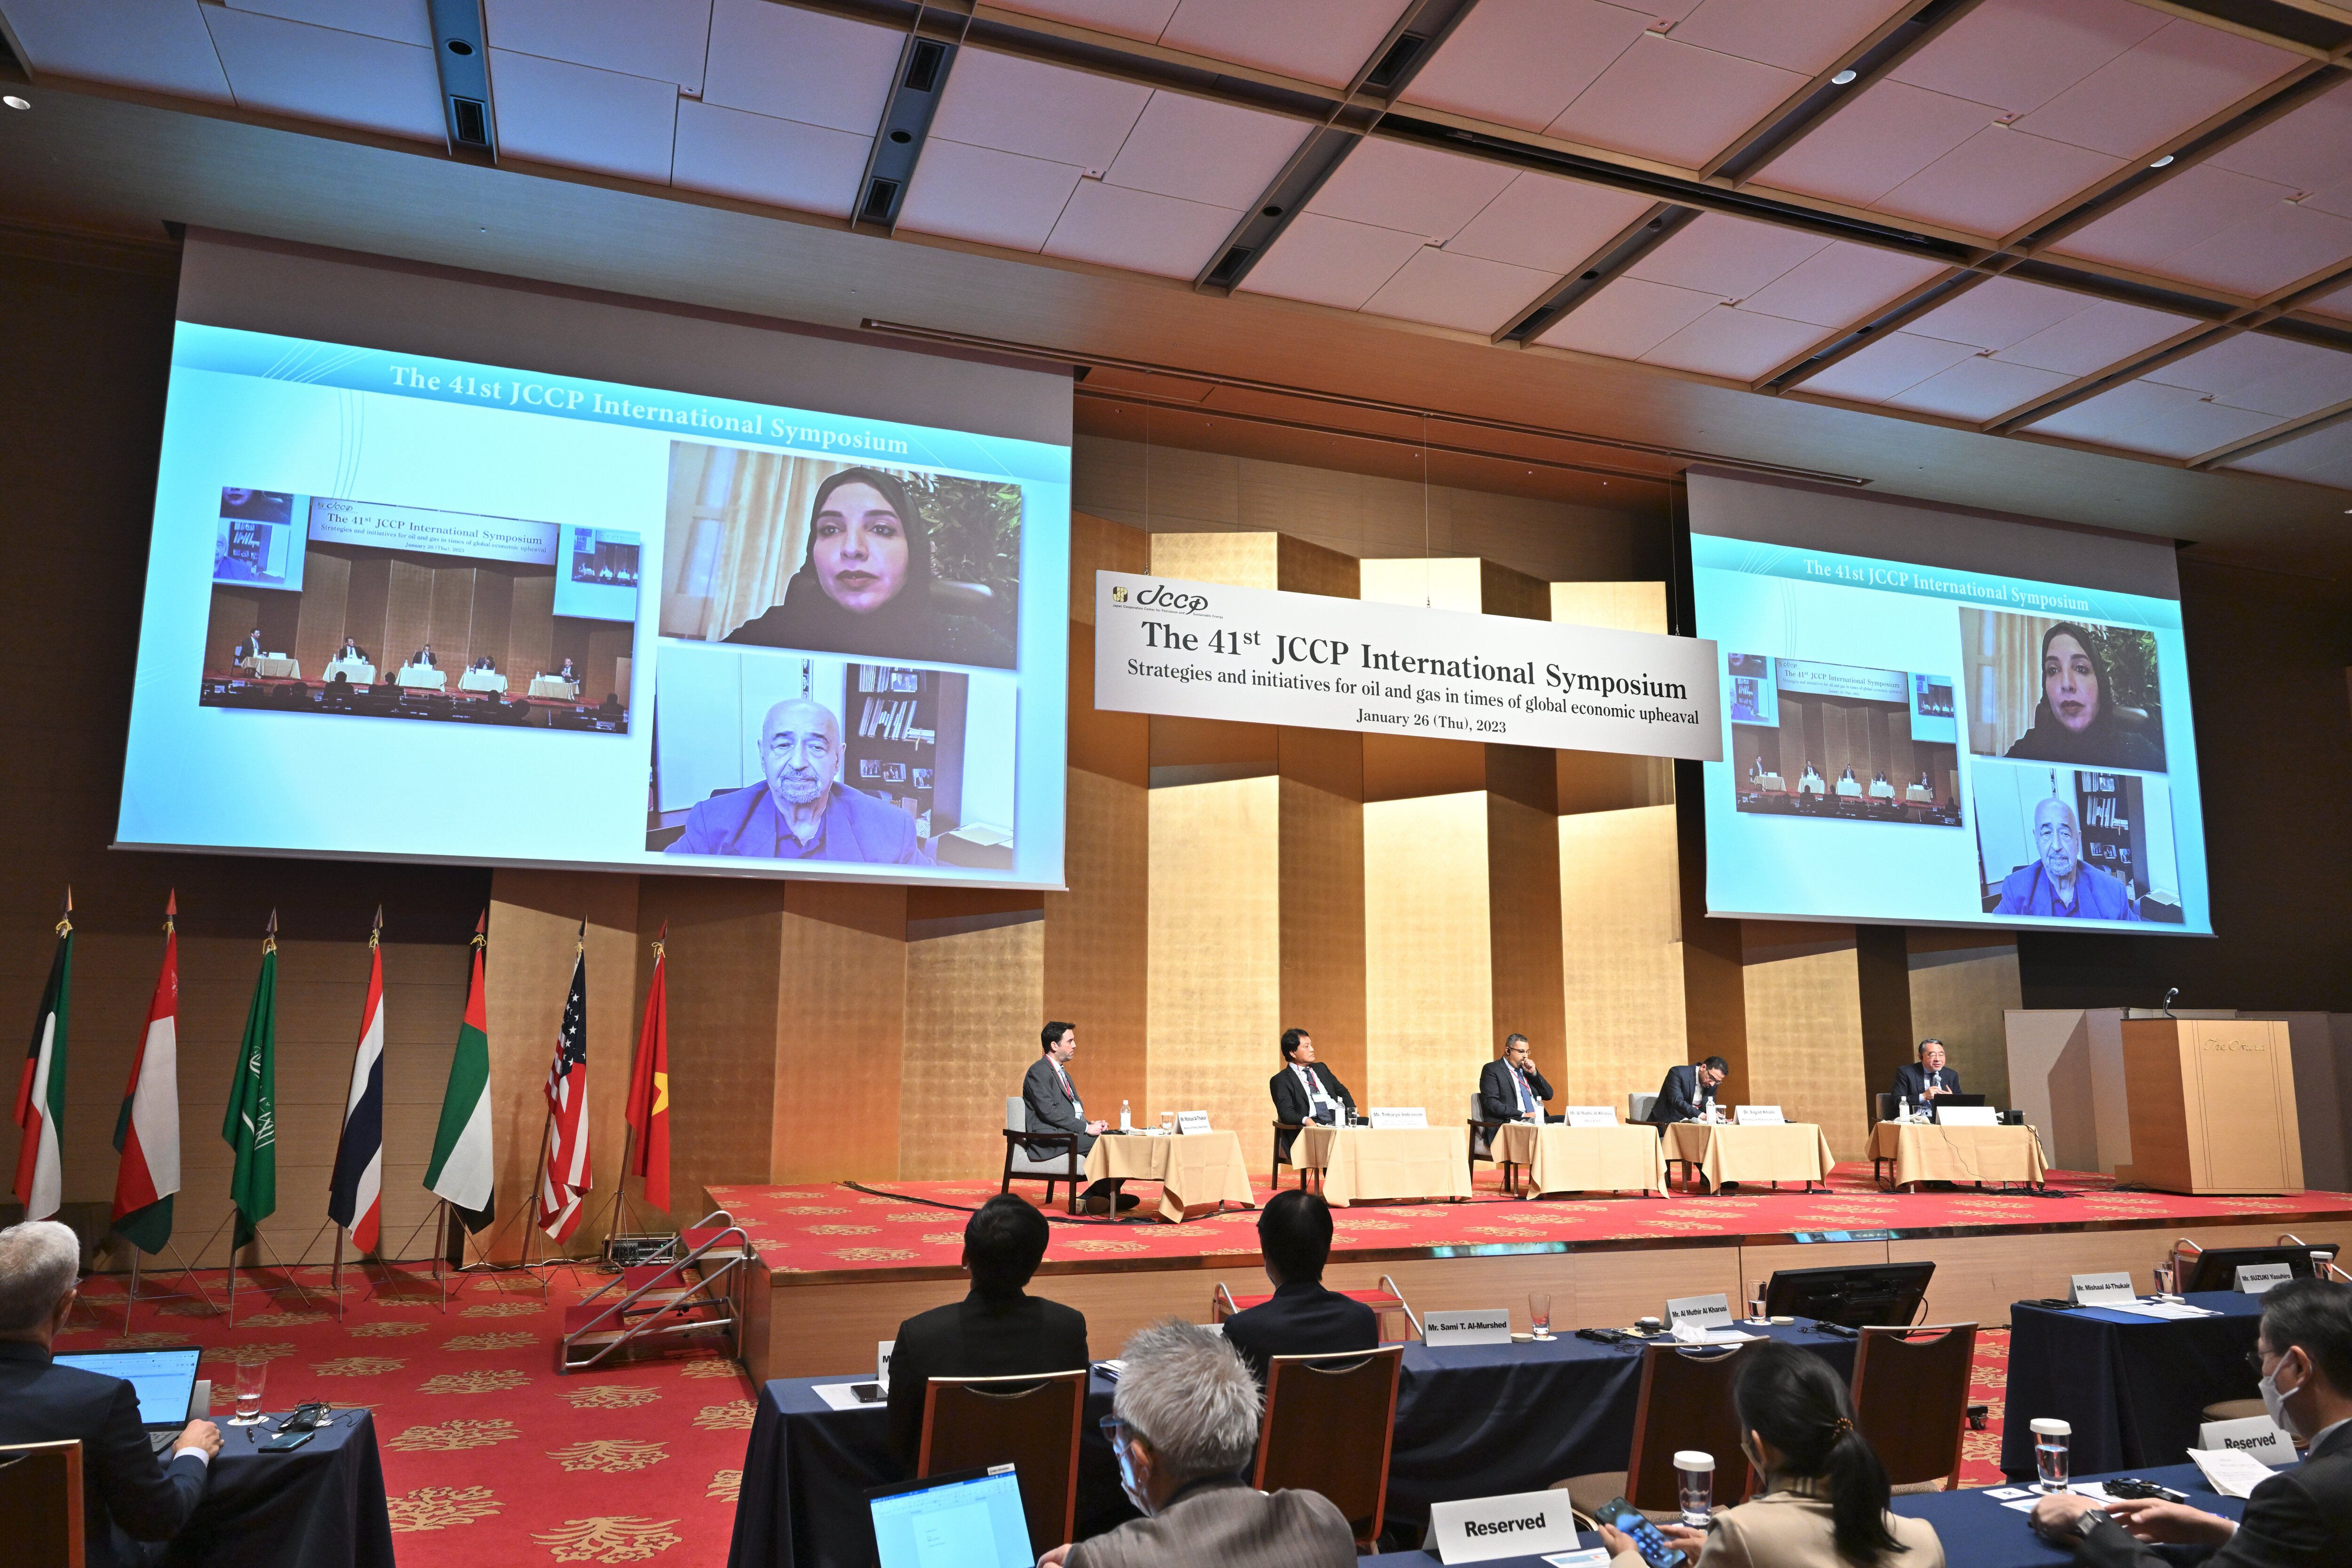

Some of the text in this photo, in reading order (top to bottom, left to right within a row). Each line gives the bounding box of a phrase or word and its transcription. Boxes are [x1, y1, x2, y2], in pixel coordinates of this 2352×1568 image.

[390, 365, 908, 454] The 41st JCCP International Symposium
[321, 524, 351, 533] Strategies
[327, 513, 348, 523] The
[375, 518, 404, 529] JCCP
[410, 522, 477, 537] International
[483, 531, 542, 544] Symposium
[1804, 559, 2089, 611] The 41st JCCP International Symposium
[1141, 621, 1687, 699] The 41st JCCP International Symposium
[1128, 659, 1699, 724] Strategies and initiatives for oil and gas in times of global economic upheaval
[1829, 674, 1865, 684] International
[1867, 679, 1899, 688] Symposium
[1356, 708, 1506, 732] January 26 (Thu), 2023
[2224, 1432, 2276, 1449] Reserved
[1464, 1512, 1546, 1537] Reserved
